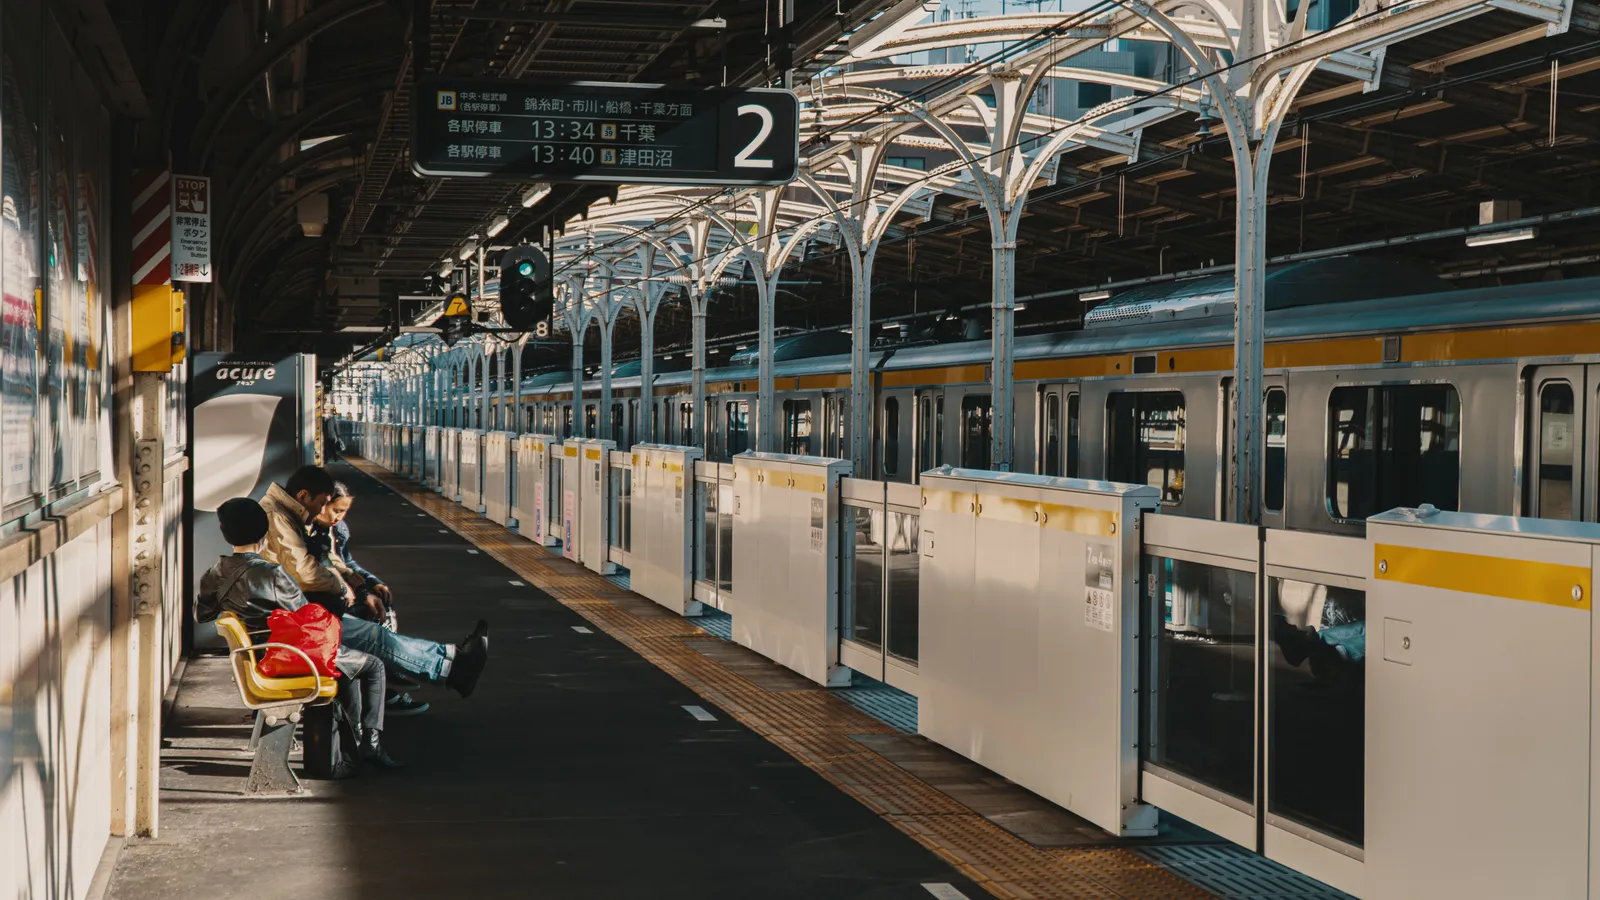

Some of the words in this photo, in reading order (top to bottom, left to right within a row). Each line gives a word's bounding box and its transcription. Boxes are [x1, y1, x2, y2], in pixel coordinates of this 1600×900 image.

[440, 96, 453, 106] JB
[460, 92, 508, 102] 中央・総武線
[524, 98, 692, 116] 錦糸町・市川・船橋・千葉方面
[448, 120, 502, 134] 各駅停車
[532, 120, 596, 140] 13:34
[620, 124, 656, 142] 千葉
[733, 104, 775, 168] 2
[448, 144, 502, 158] 各駅停車
[531, 145, 595, 165] 13:40
[620, 148, 673, 168] 津田沼
[178, 180, 206, 190] STOP
[176, 216, 208, 228] 非常停止
[184, 228, 206, 238] ボタン
[453, 302, 462, 313] 7
[536, 321, 548, 336] 8
[216, 368, 276, 380] acure
